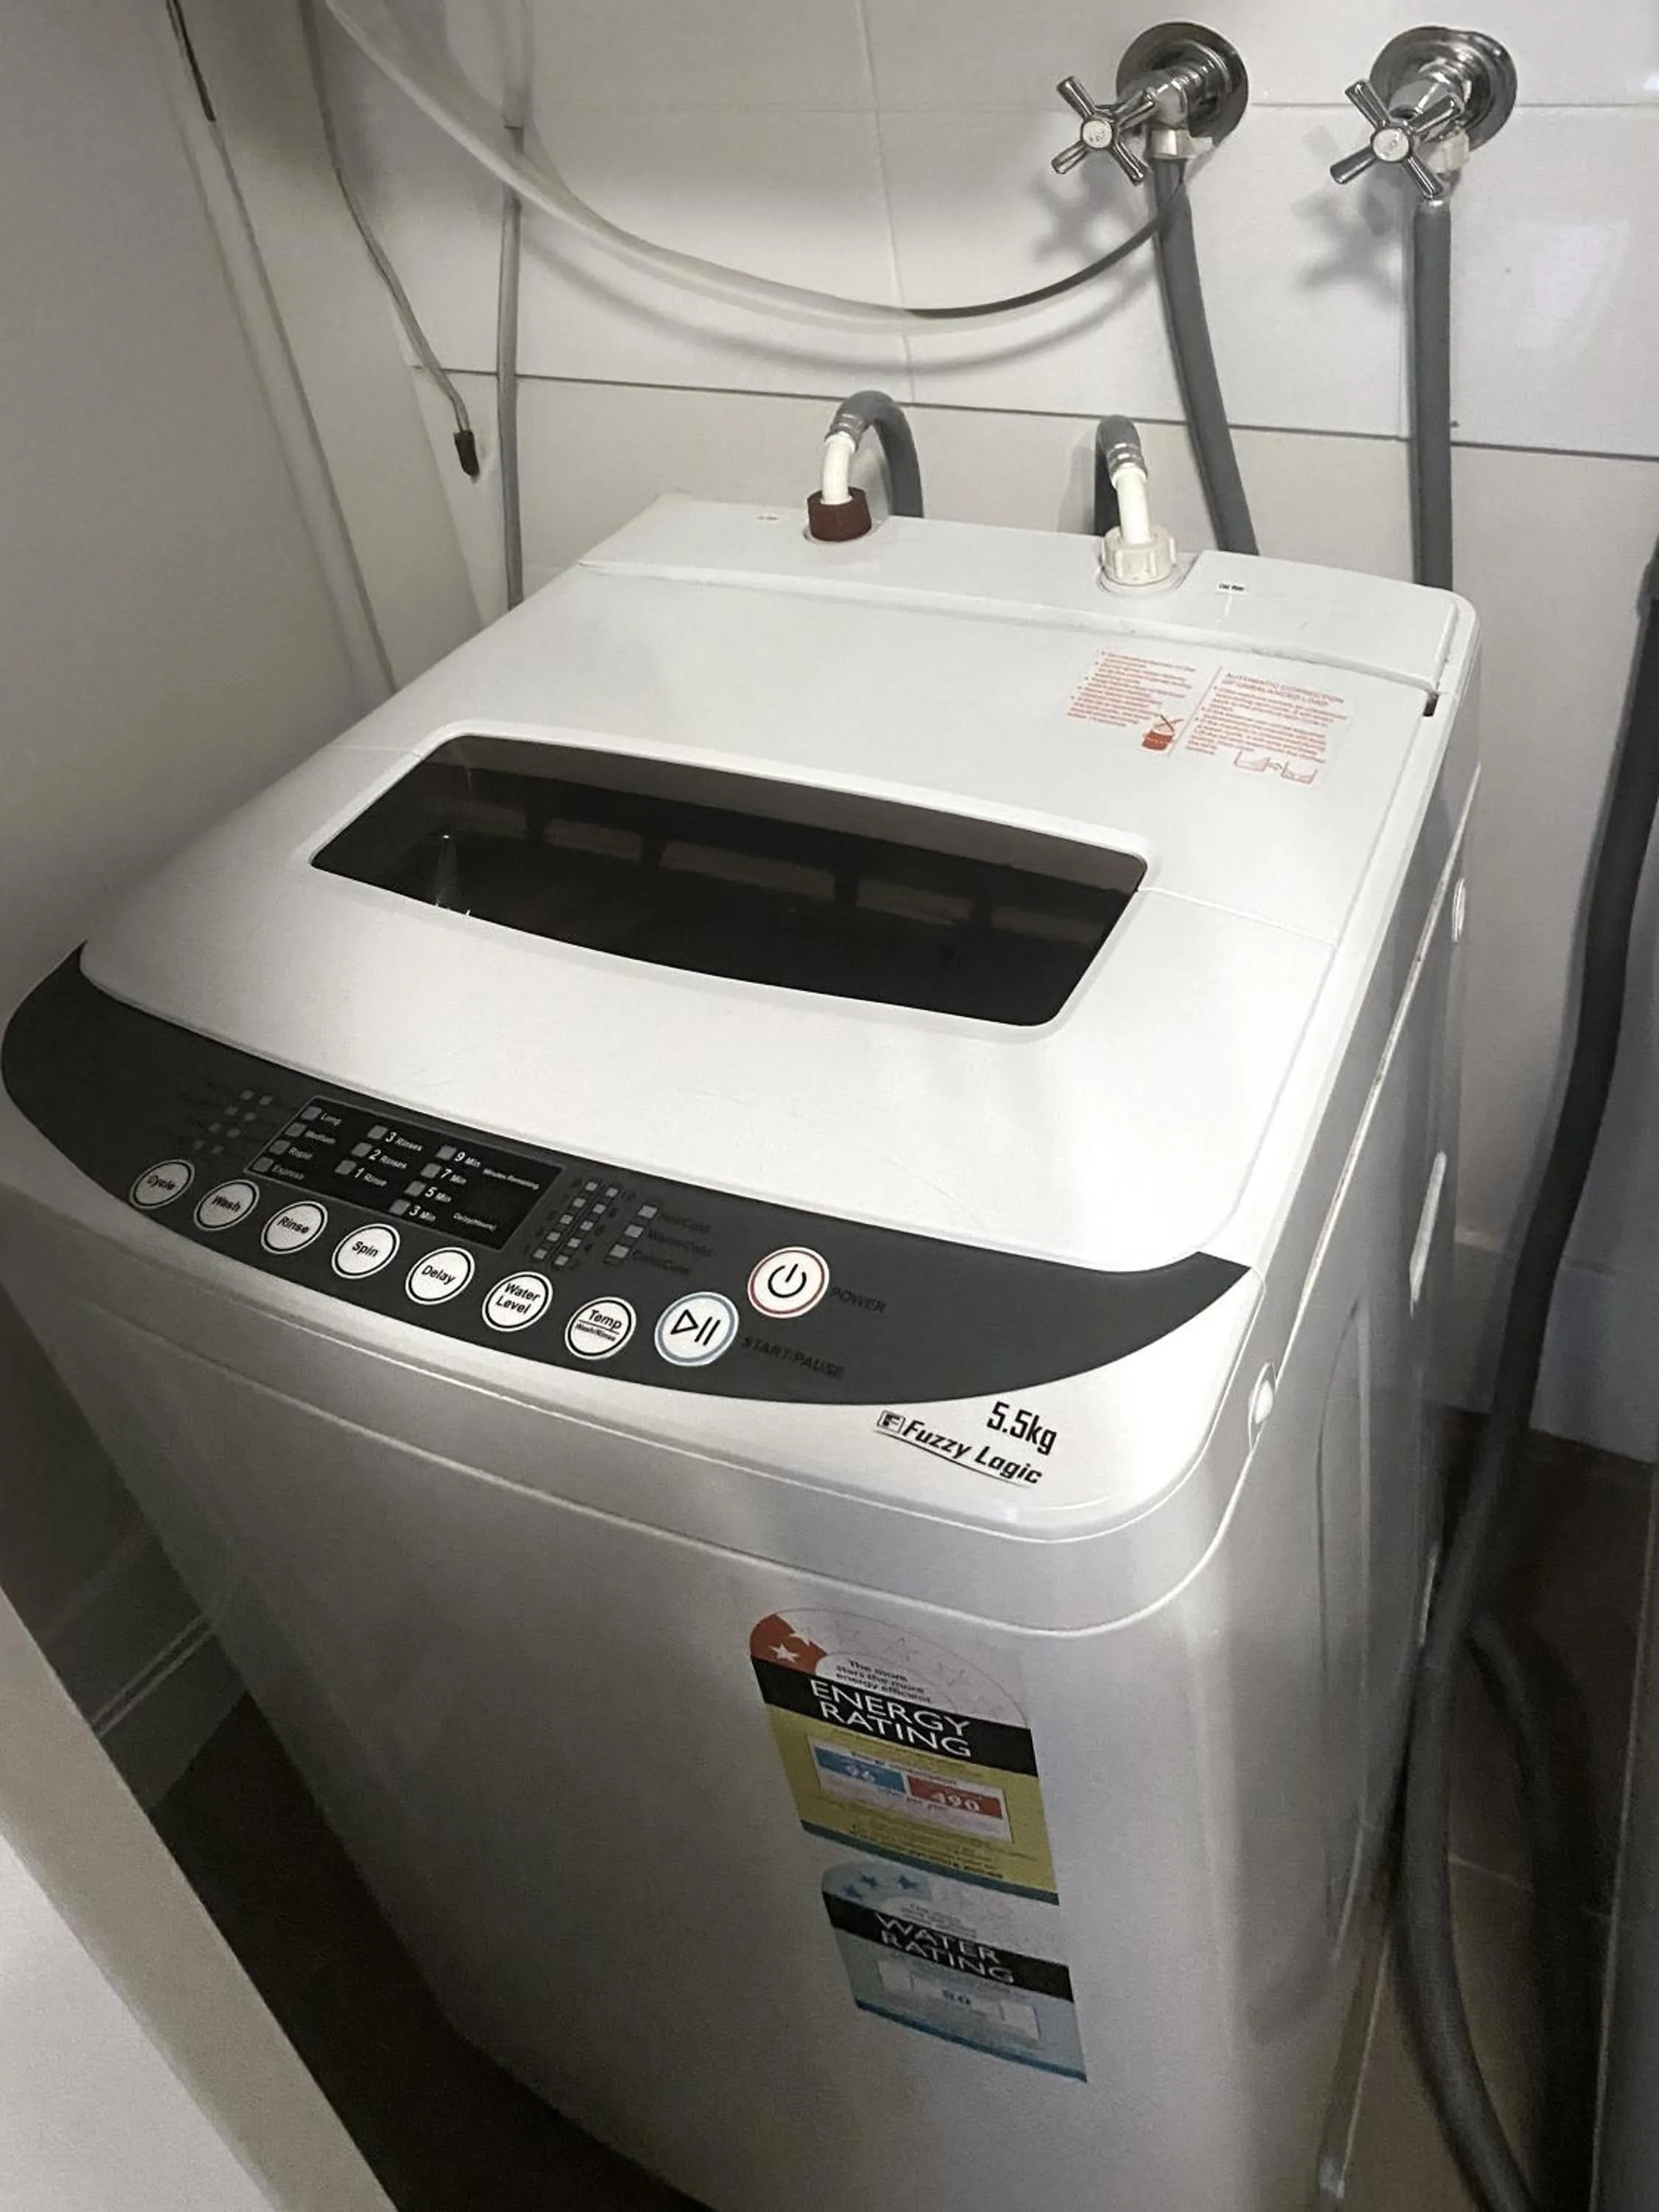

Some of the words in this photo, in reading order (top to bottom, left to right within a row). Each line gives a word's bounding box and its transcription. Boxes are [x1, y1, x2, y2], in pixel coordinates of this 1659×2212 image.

[320, 1113, 342, 1126] Long
[385, 1132, 397, 1143] 3
[394, 1138, 423, 1152] Rinses
[369, 1149, 382, 1161] 2
[379, 1155, 408, 1169] Rinses
[454, 1151, 466, 1163] 9
[465, 1157, 481, 1168] Min
[147, 1175, 176, 1191] Cycle
[355, 1167, 365, 1179] 1
[364, 1173, 388, 1187] Rinse
[441, 1169, 453, 1180] 7
[450, 1174, 467, 1185] Min
[212, 1194, 242, 1213] Wash
[425, 1186, 438, 1198] 5
[434, 1192, 452, 1203] Min
[409, 1205, 422, 1217] 3
[420, 1211, 436, 1222] Min
[276, 1216, 310, 1234] Rinse
[352, 1241, 378, 1257] Spin
[421, 1265, 456, 1285] Delay
[504, 1283, 540, 1302] Water
[831, 1287, 886, 1314] POWER
[495, 1295, 531, 1315] Level
[588, 1309, 622, 1330] Temp
[987, 1401, 1057, 1455] 5.5kg
[902, 1419, 973, 1459] Fuzzy
[974, 1446, 1043, 1484] Logic
[836, 1665, 865, 1678] stars
[866, 1672, 886, 1684] the
[891, 1677, 925, 1694] more
[849, 1660, 872, 1672] The
[874, 1666, 908, 1683] more
[836, 1672, 878, 1690] energy
[881, 1684, 932, 1703] efficient
[810, 1679, 971, 1736] ENERGY
[819, 1701, 971, 1757] RATING
[875, 1912, 1001, 1964] WATER
[881, 1930, 1015, 1983] RATING
